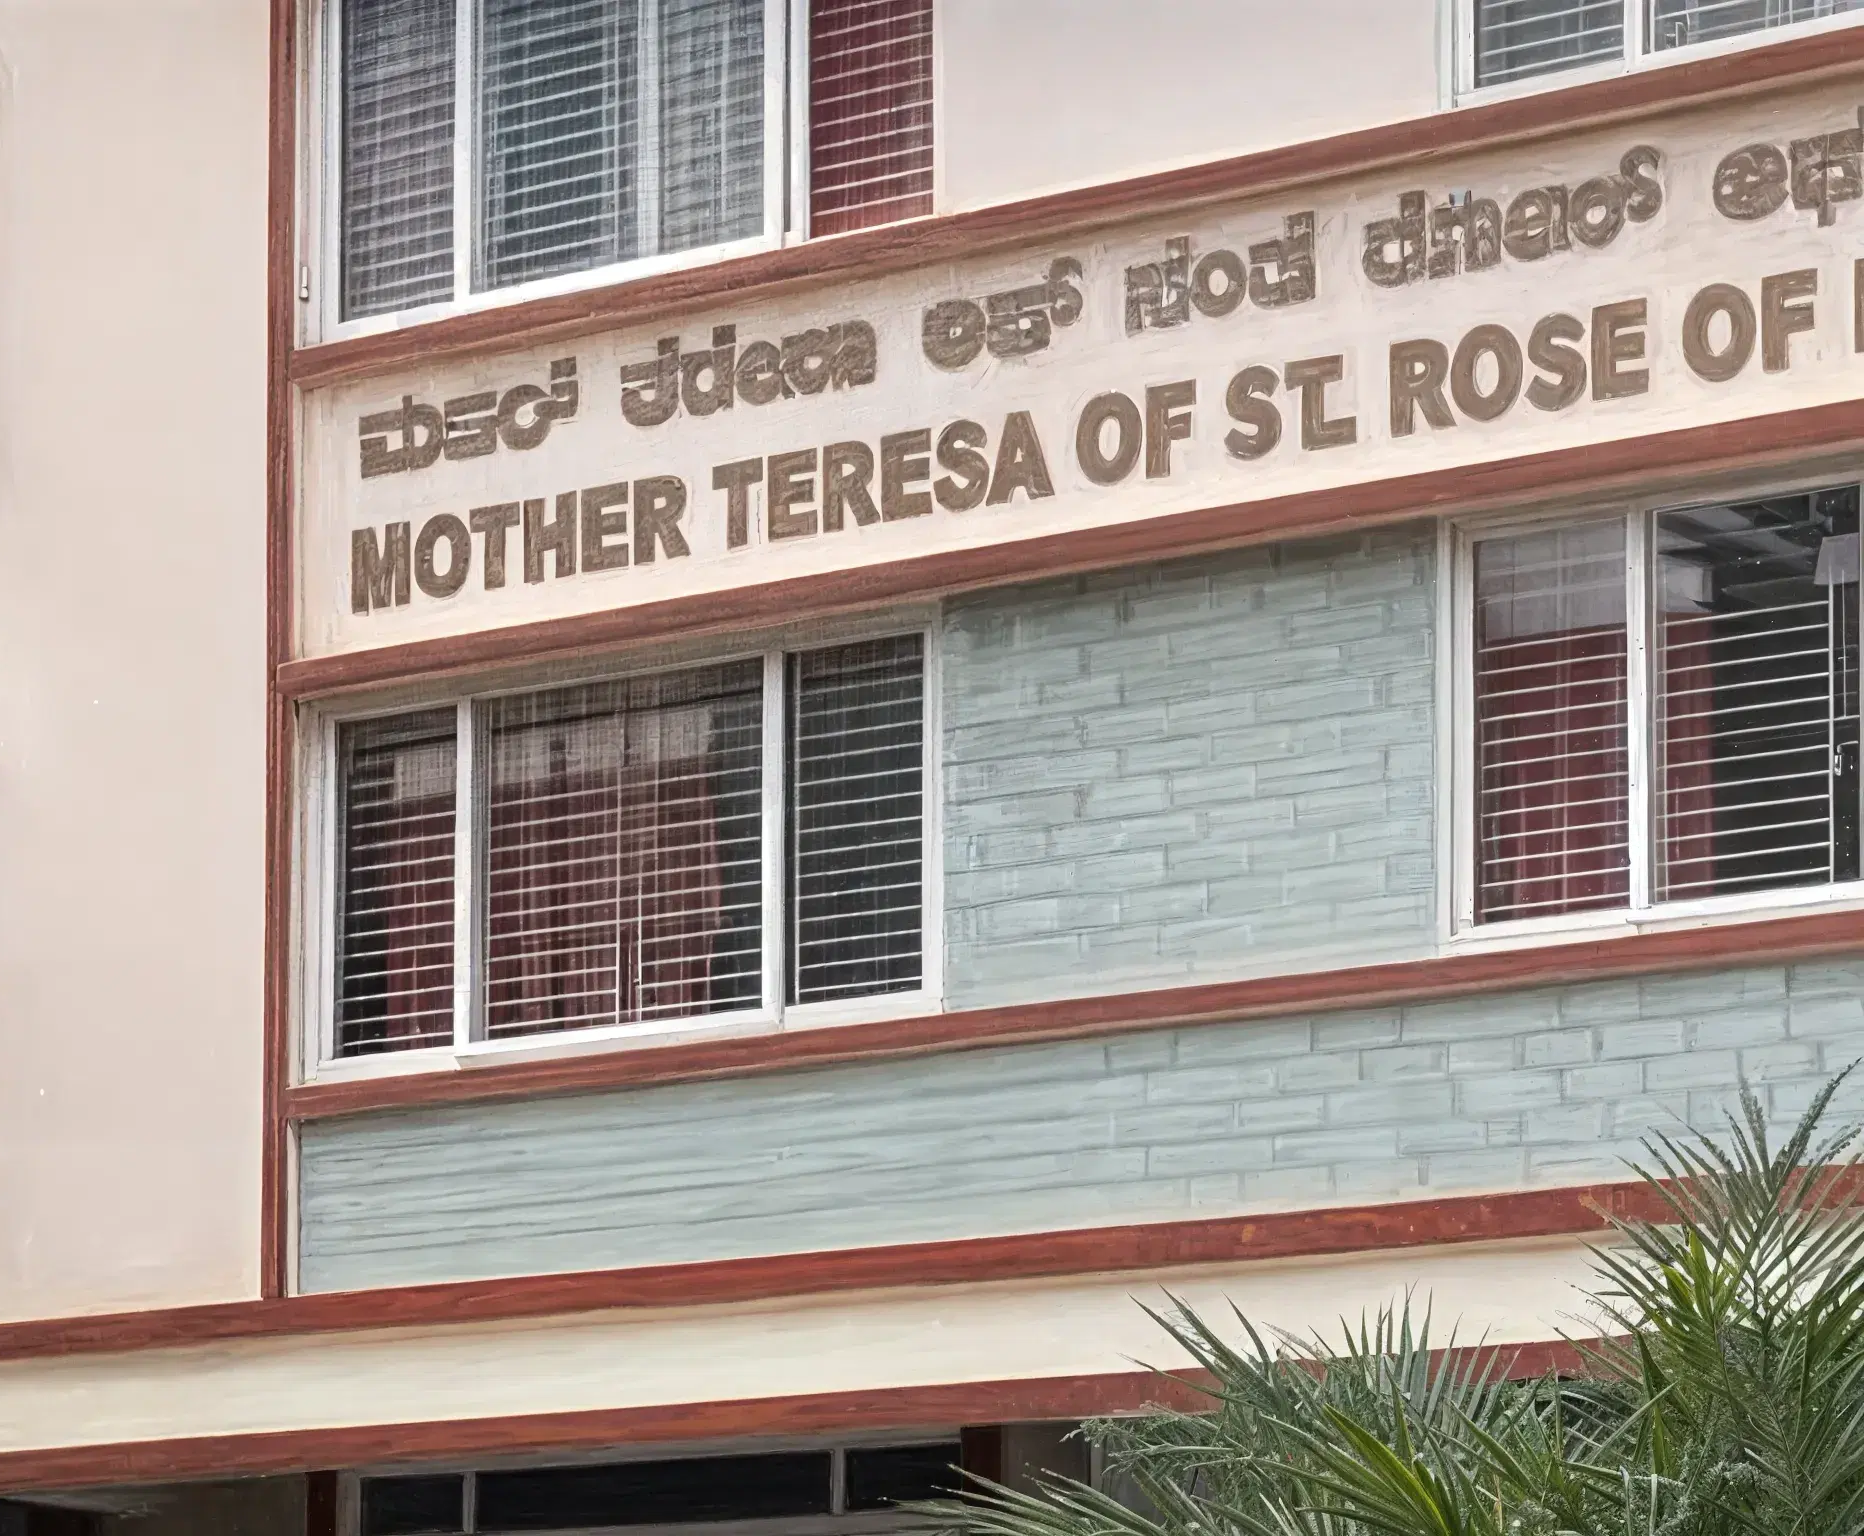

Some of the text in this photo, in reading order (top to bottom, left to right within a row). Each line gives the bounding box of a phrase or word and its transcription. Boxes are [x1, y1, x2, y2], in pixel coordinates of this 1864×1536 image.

[351, 474, 692, 617] MOTHER
[712, 410, 1055, 549] TERESA
[1075, 378, 1197, 485] OF
[1389, 297, 1650, 438] ROSE
[1682, 267, 1819, 383] OF
